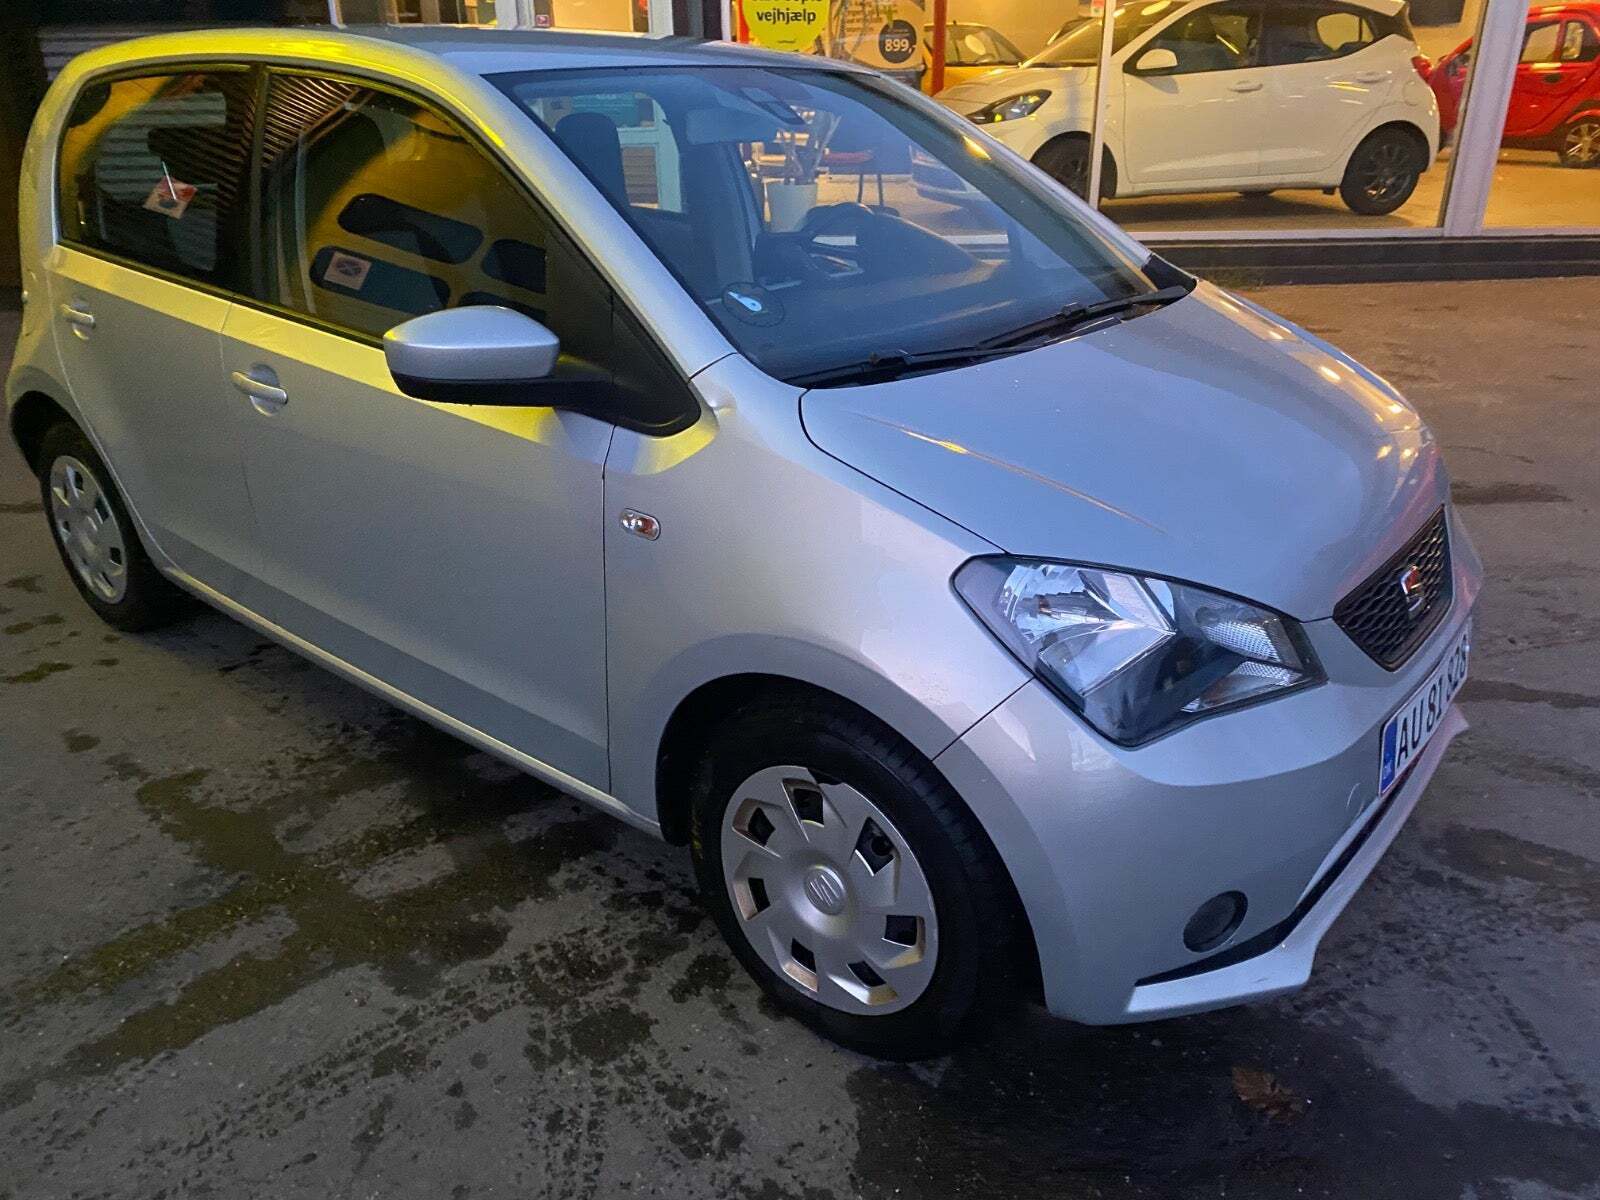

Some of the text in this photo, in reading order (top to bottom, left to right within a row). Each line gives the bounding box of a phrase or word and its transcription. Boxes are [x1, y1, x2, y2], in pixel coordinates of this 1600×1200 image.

[756, 8, 816, 25] vejhjælp
[1397, 699, 1424, 767] AU
[1427, 676, 1443, 733] 81
